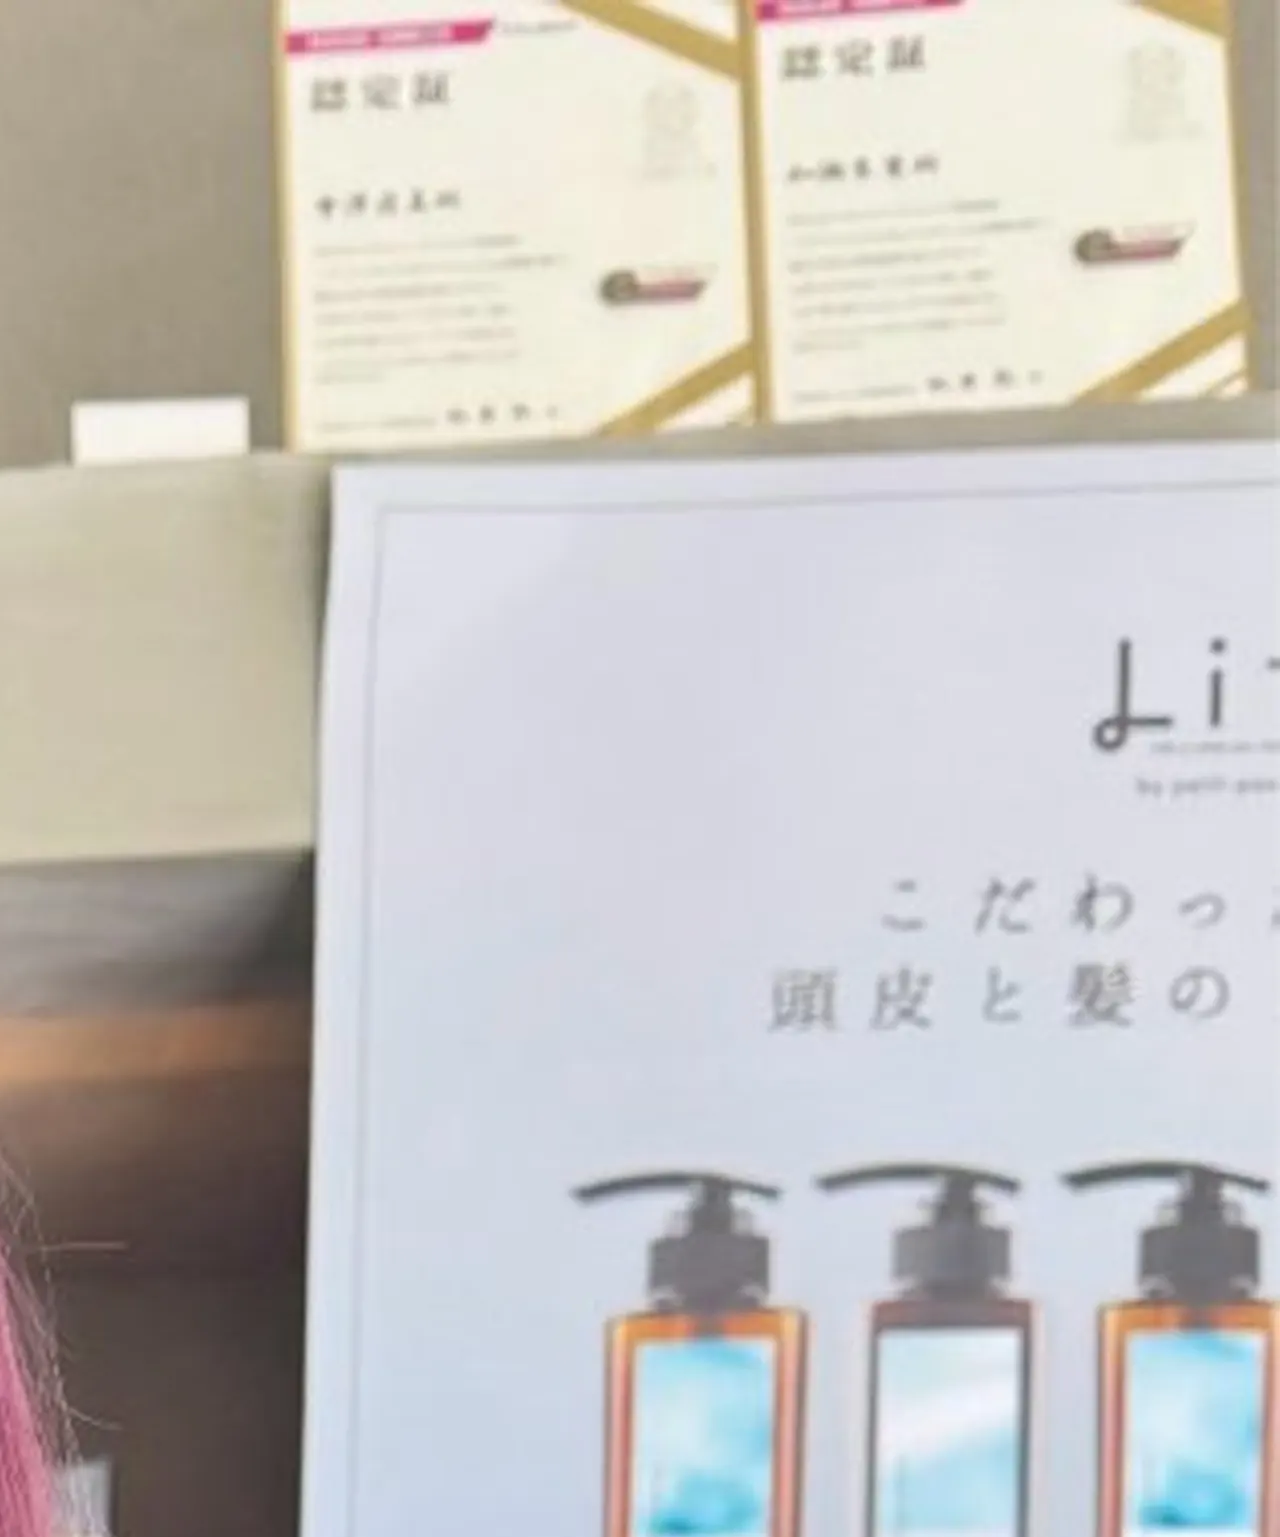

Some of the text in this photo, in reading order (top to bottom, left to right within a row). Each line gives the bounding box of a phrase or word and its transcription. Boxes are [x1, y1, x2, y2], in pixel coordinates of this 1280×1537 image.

[1092, 637, 1280, 752] Li
[881, 872, 1280, 935] こだわっ
